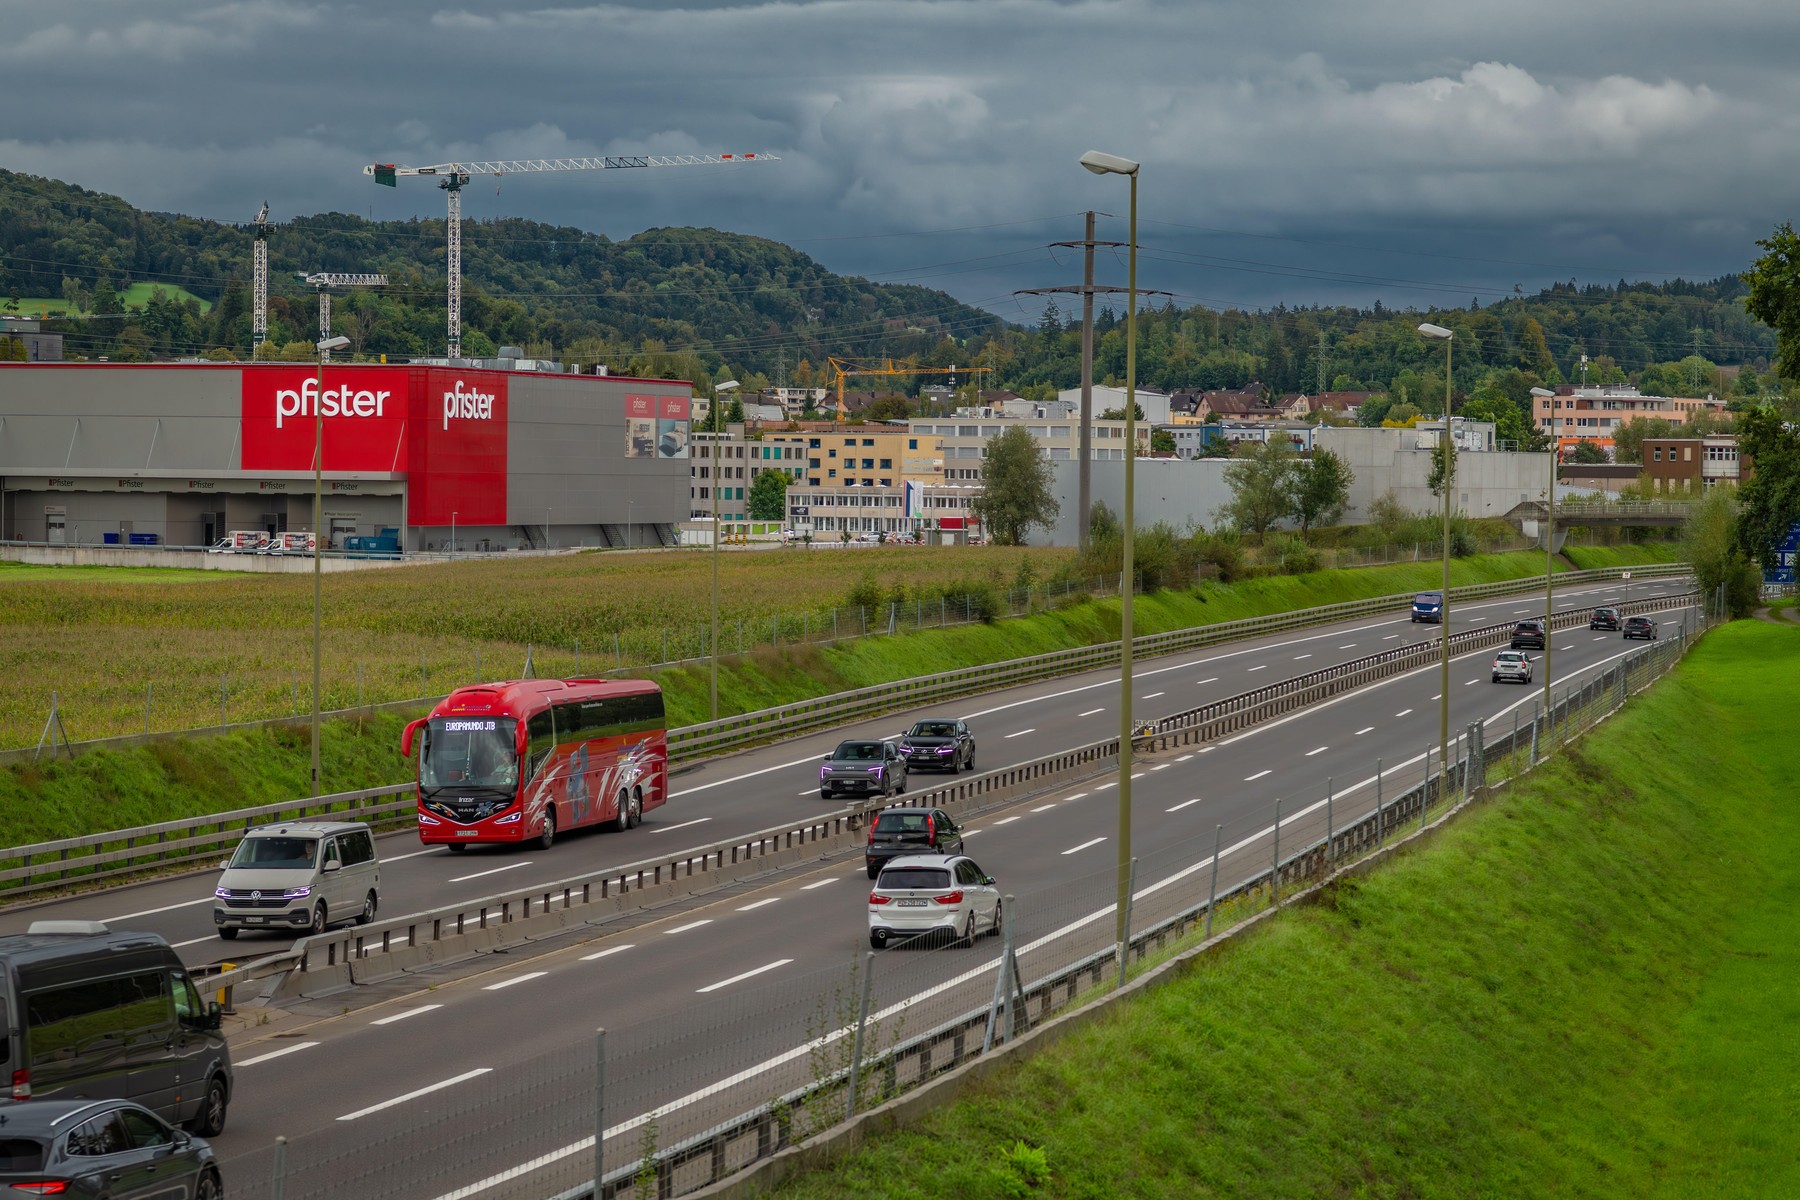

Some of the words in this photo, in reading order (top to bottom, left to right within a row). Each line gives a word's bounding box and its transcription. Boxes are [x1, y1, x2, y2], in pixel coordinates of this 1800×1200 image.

[276, 377, 391, 429] pfister
[443, 379, 495, 431] pfister
[52, 478, 74, 487] Pfister
[122, 479, 144, 488] Pfister
[192, 480, 214, 489] Pfister
[264, 481, 286, 490] Pfister
[336, 482, 358, 491] Pfister
[445, 721, 484, 731] EUROPAMUNDO
[485, 721, 496, 731] JTB
